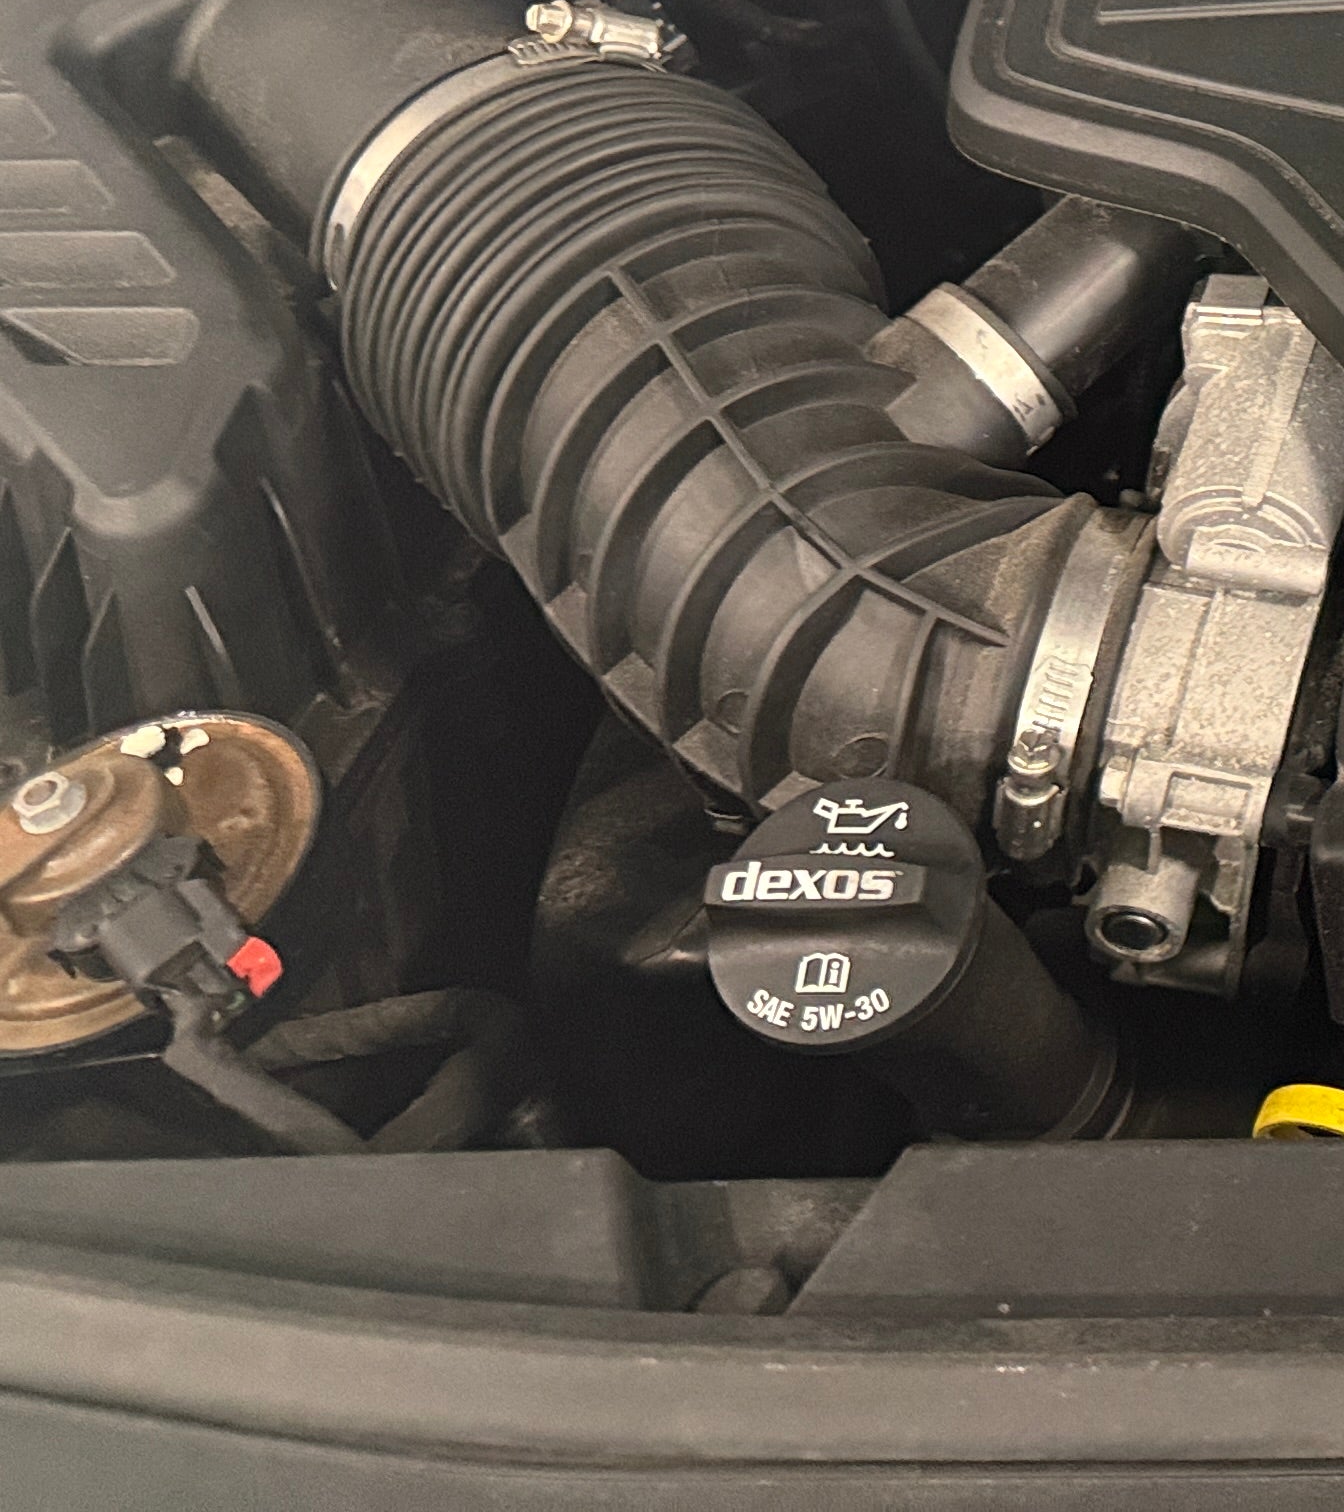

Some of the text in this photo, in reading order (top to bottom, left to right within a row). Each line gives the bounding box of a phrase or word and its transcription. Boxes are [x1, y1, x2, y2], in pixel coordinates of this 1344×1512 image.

[721, 861, 897, 902] dexos
[747, 987, 891, 1032] SAE 5W-30
